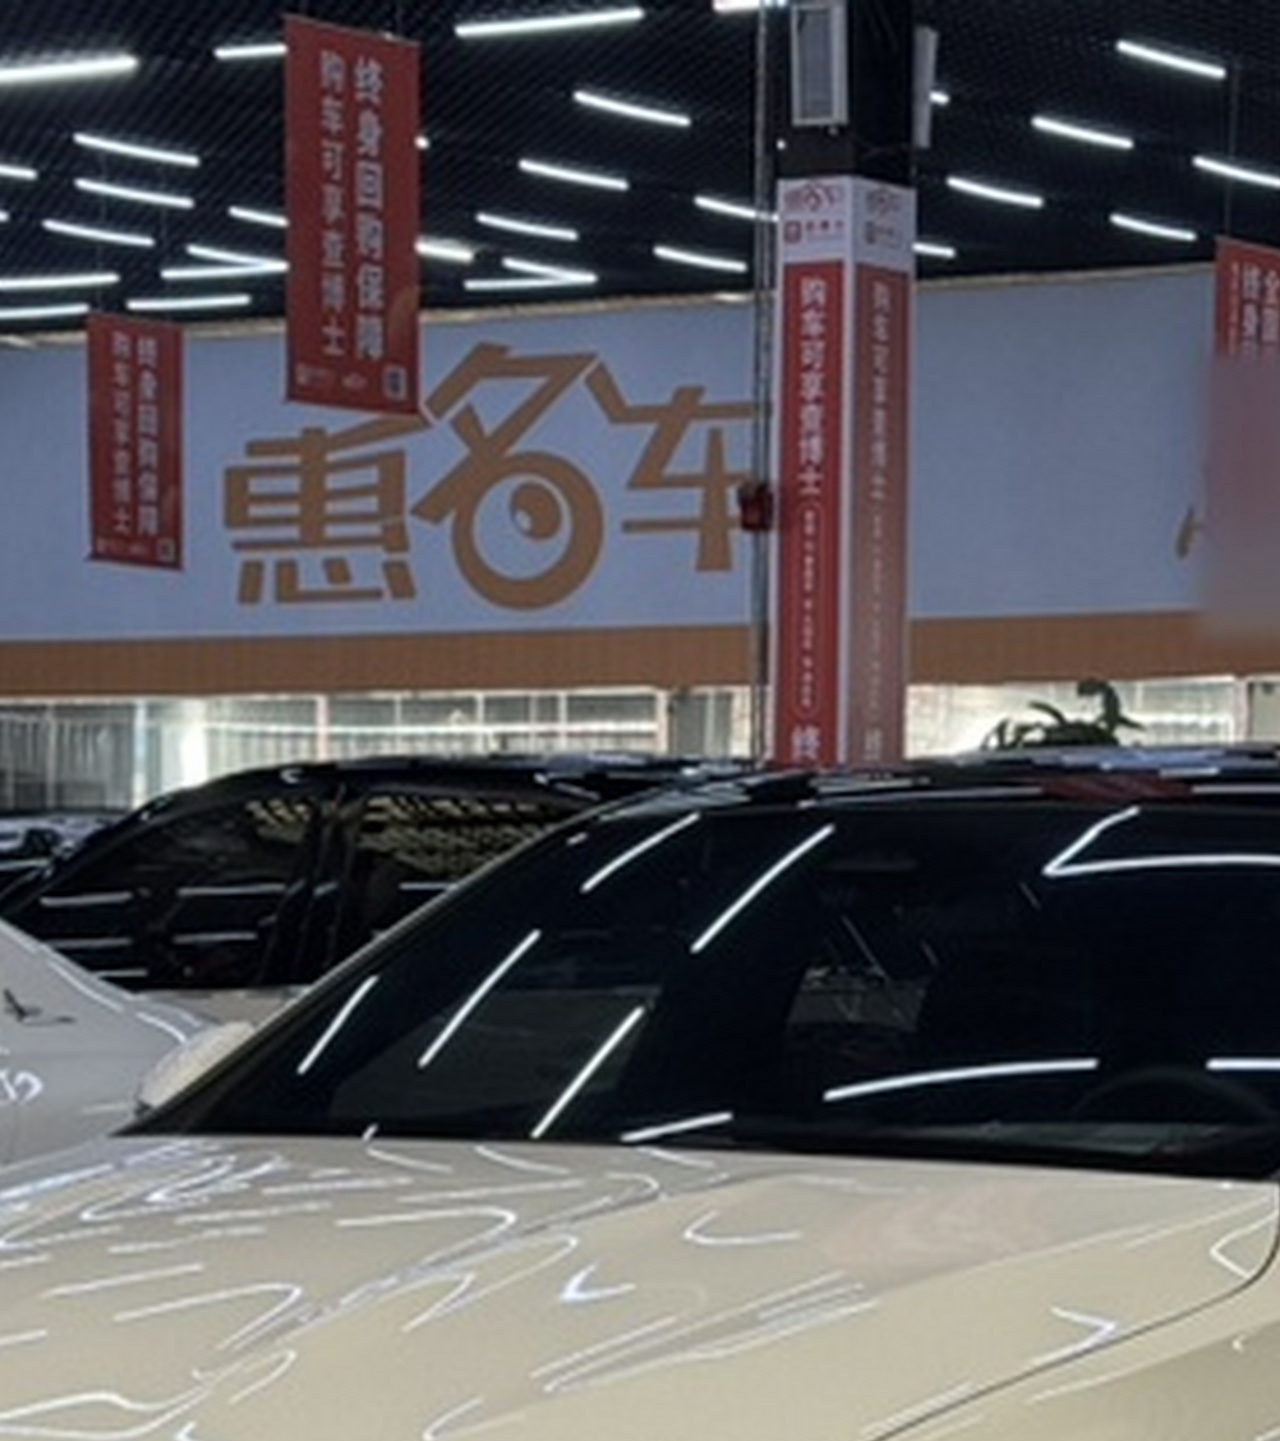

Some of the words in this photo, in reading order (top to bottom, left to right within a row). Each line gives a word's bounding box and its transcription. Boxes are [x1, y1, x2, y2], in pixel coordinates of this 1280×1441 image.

[353, 54, 385, 361] 终身回购保障
[222, 341, 756, 611] 惠名车
